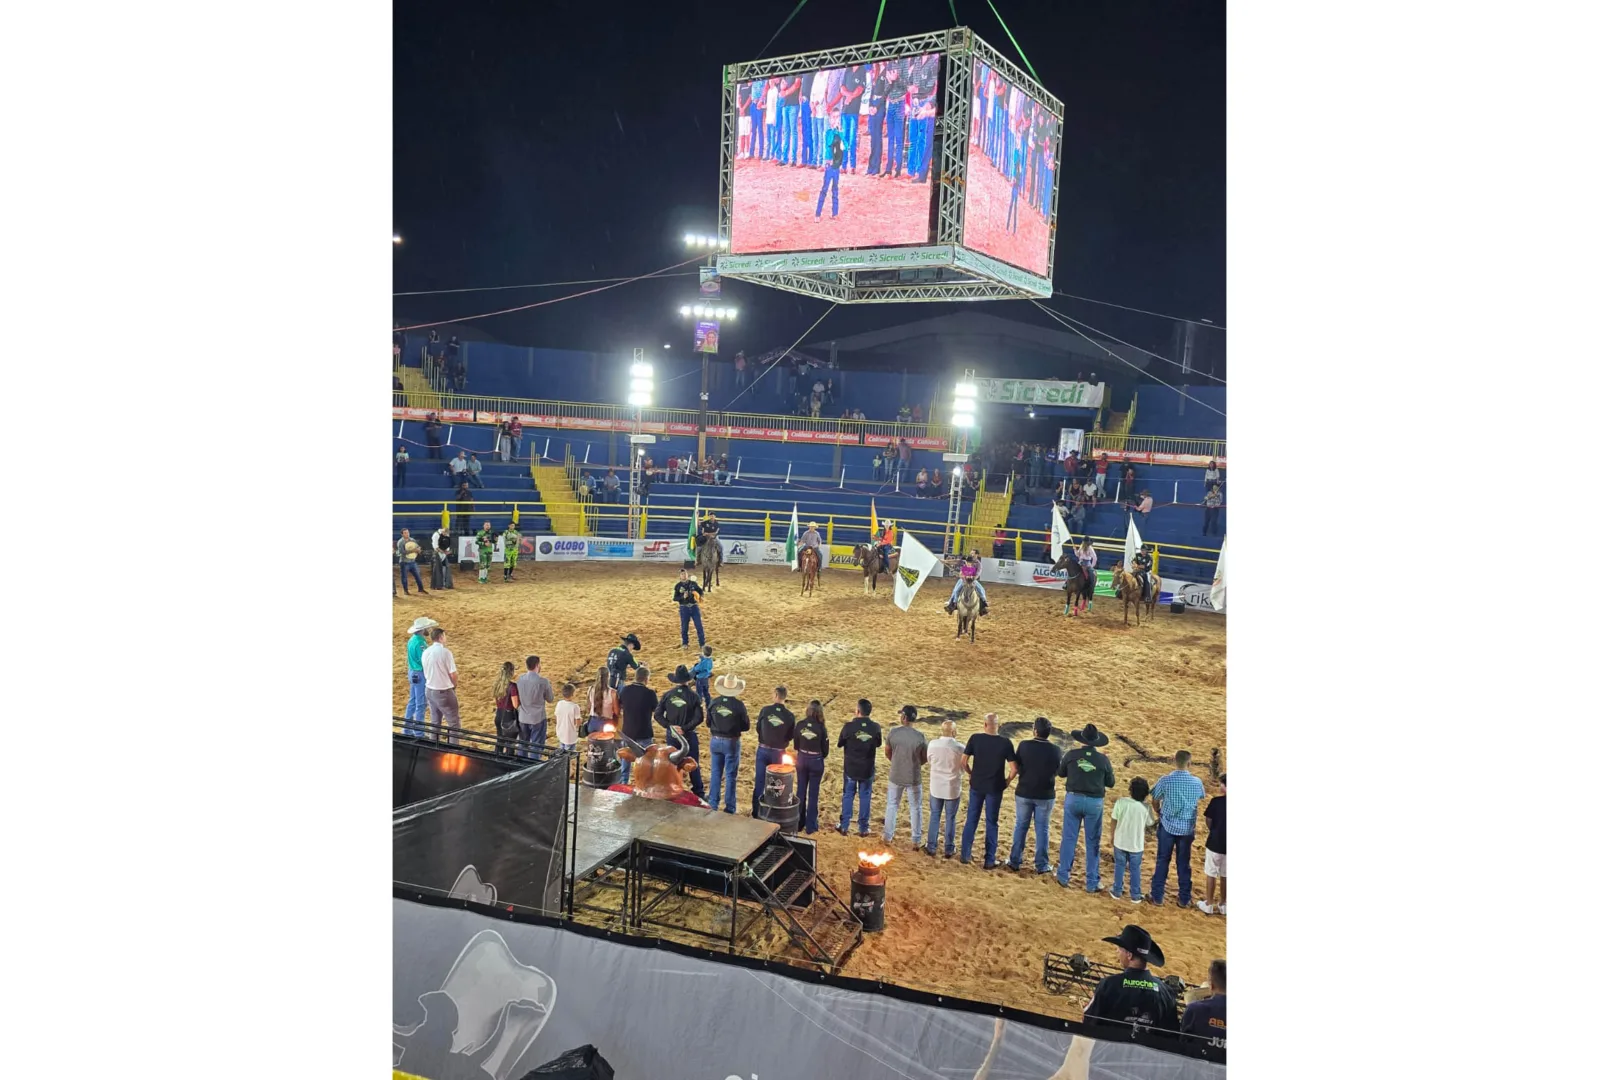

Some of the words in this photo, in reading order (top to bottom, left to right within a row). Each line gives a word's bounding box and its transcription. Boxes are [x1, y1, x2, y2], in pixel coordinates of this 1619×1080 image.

[728, 261, 752, 269] Sicredi
[801, 257, 825, 266] Sicredi
[840, 255, 865, 264] Sicredi
[880, 253, 906, 262] Sicredi
[921, 250, 949, 260] Sicredi
[1000, 379, 1086, 404] Sicredi
[554, 540, 585, 551] GLOBO
